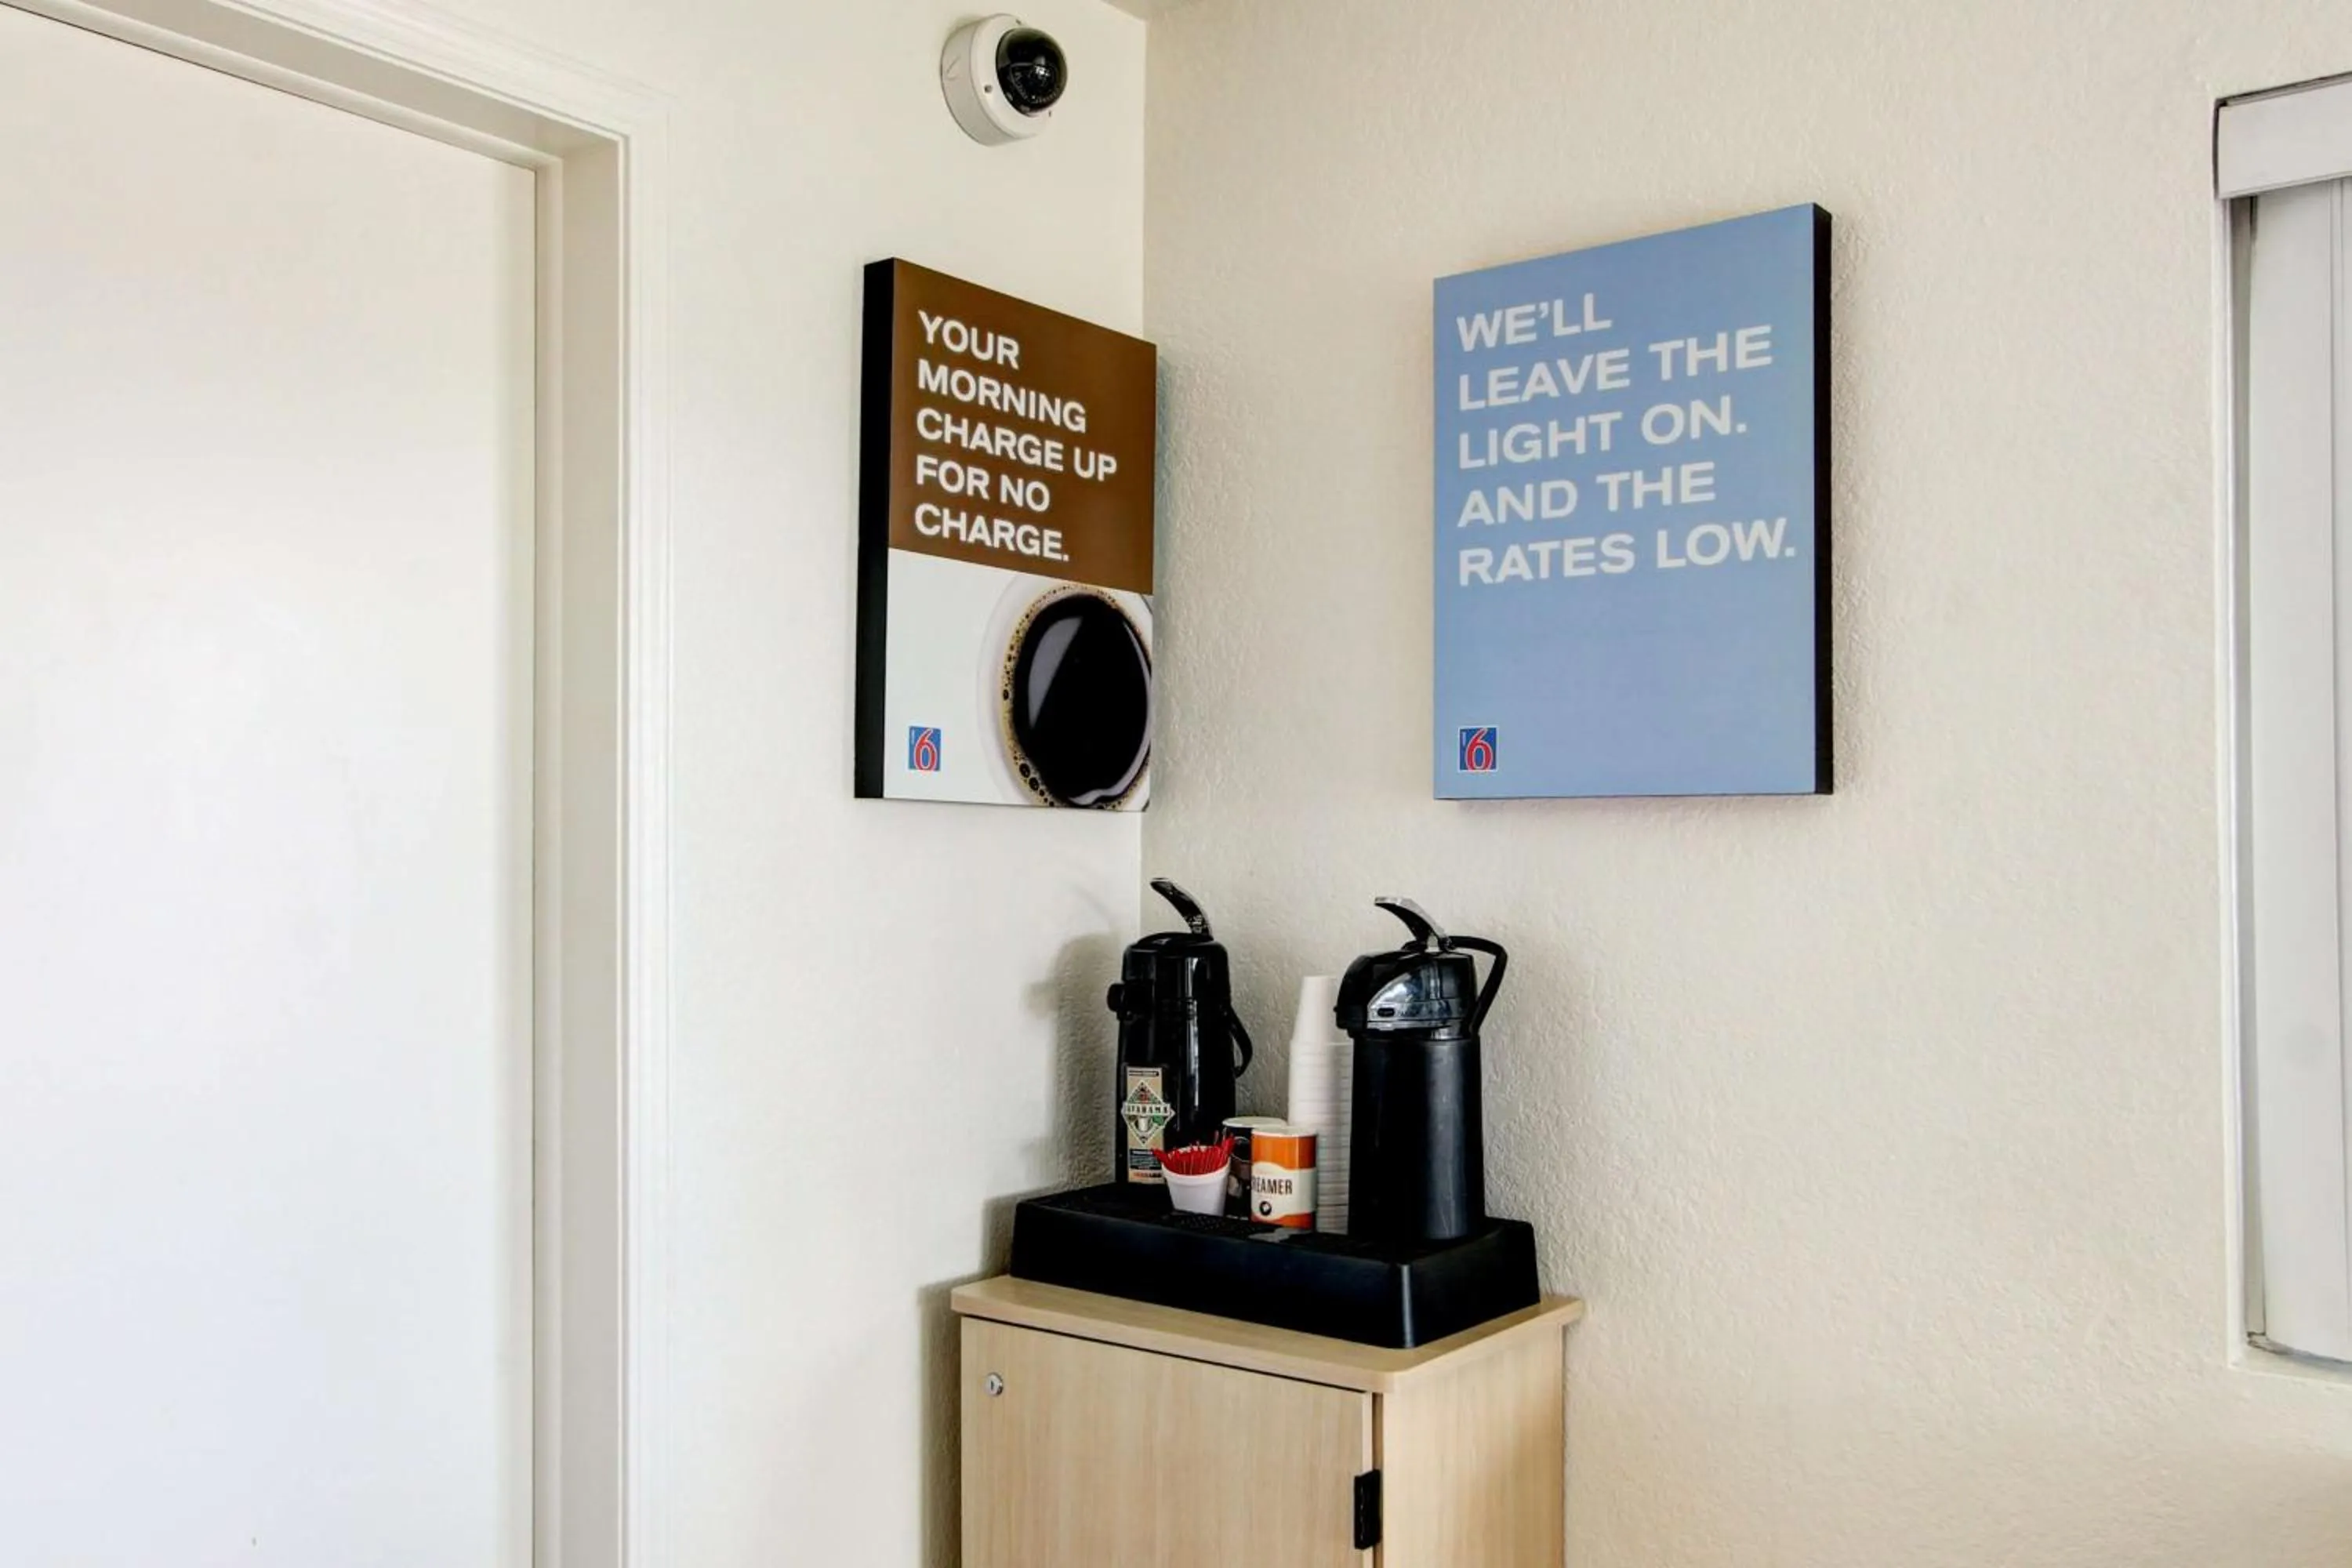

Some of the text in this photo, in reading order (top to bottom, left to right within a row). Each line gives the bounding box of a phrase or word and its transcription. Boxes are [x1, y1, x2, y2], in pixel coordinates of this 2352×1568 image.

[917, 310, 1020, 369] YOUR
[1456, 292, 1613, 353] WE'LL
[917, 358, 1087, 434] MORNING
[1459, 325, 1773, 411] LEAVE THE
[916, 407, 1118, 481] CHARGE UP
[1459, 394, 1747, 469] LIGHT ON.
[916, 454, 1051, 512] FOR NO
[1457, 461, 1716, 528] AND THE
[914, 502, 1069, 562] CHARGE.
[1459, 517, 1795, 586] RATES LOW.
[913, 728, 938, 771] 6
[1465, 727, 1494, 772] 6
[1251, 1175, 1293, 1195] REAMER
